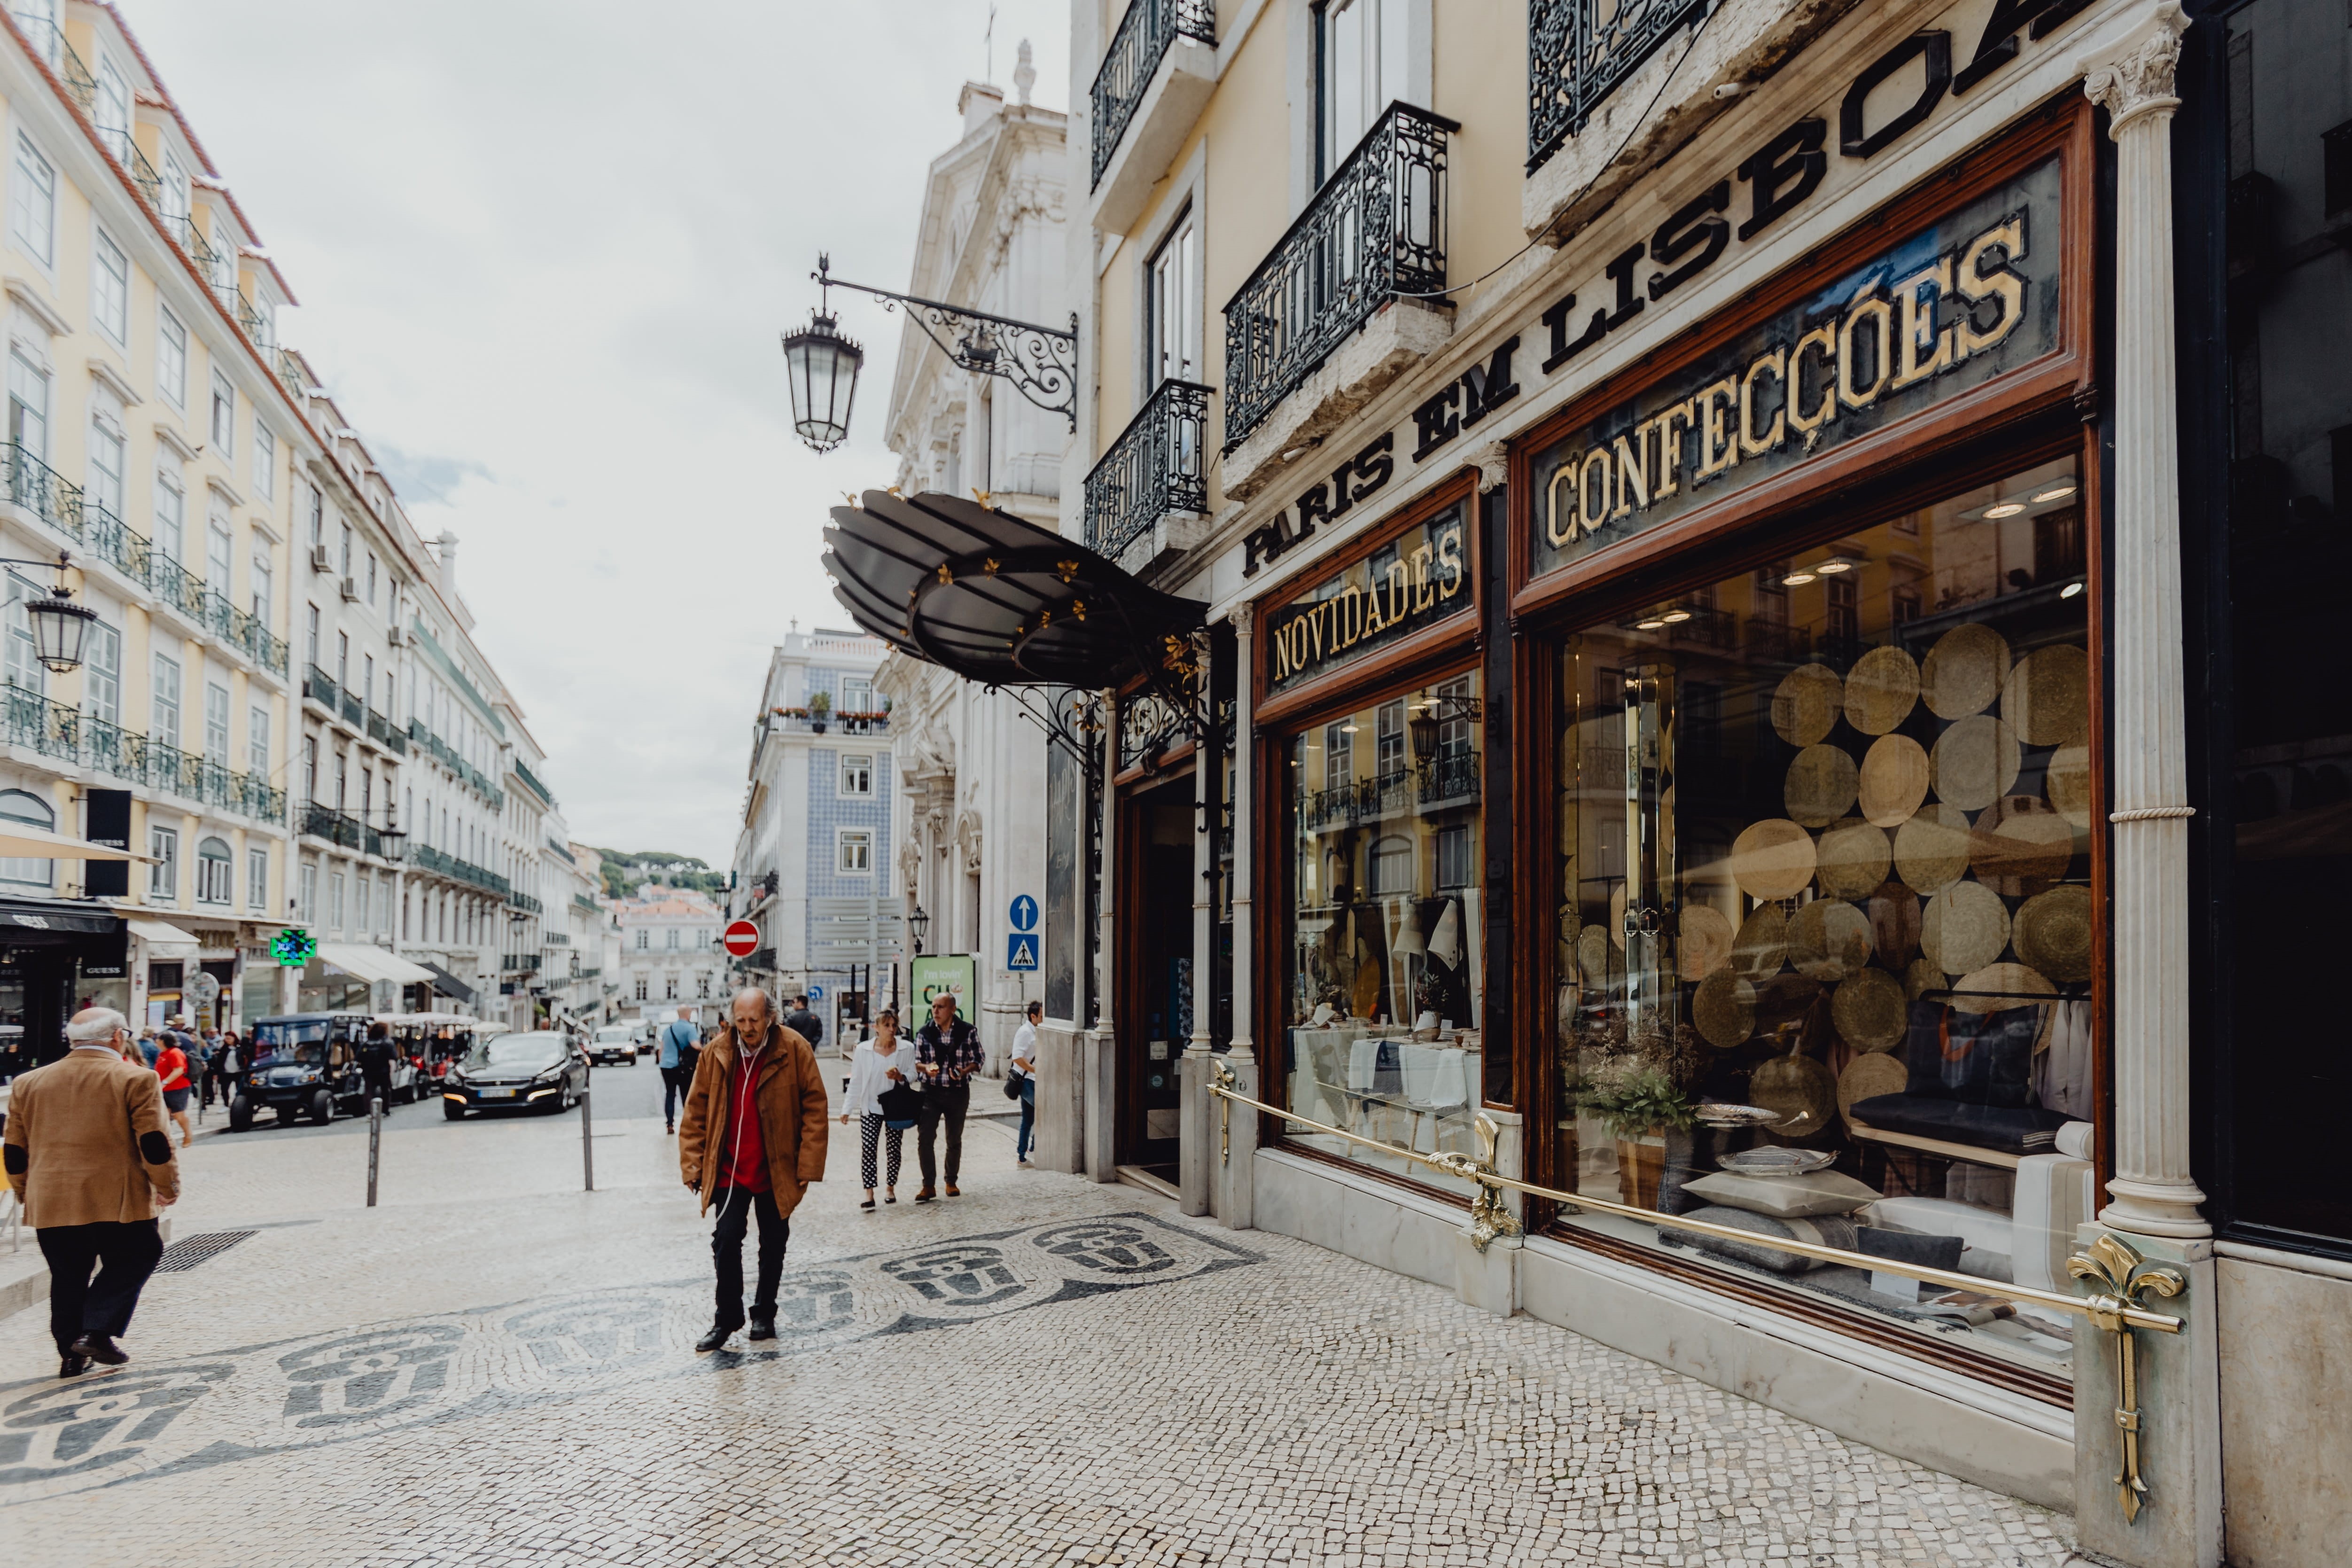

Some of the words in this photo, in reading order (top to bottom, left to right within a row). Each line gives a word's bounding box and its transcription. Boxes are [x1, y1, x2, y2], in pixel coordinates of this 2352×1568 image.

[1242, 431, 1394, 578] PARIS
[1412, 335, 1520, 463] EM
[1275, 526, 1462, 681] NOVIDADES
[924, 970, 937, 979] I'm
[940, 969, 963, 979] lovin'
